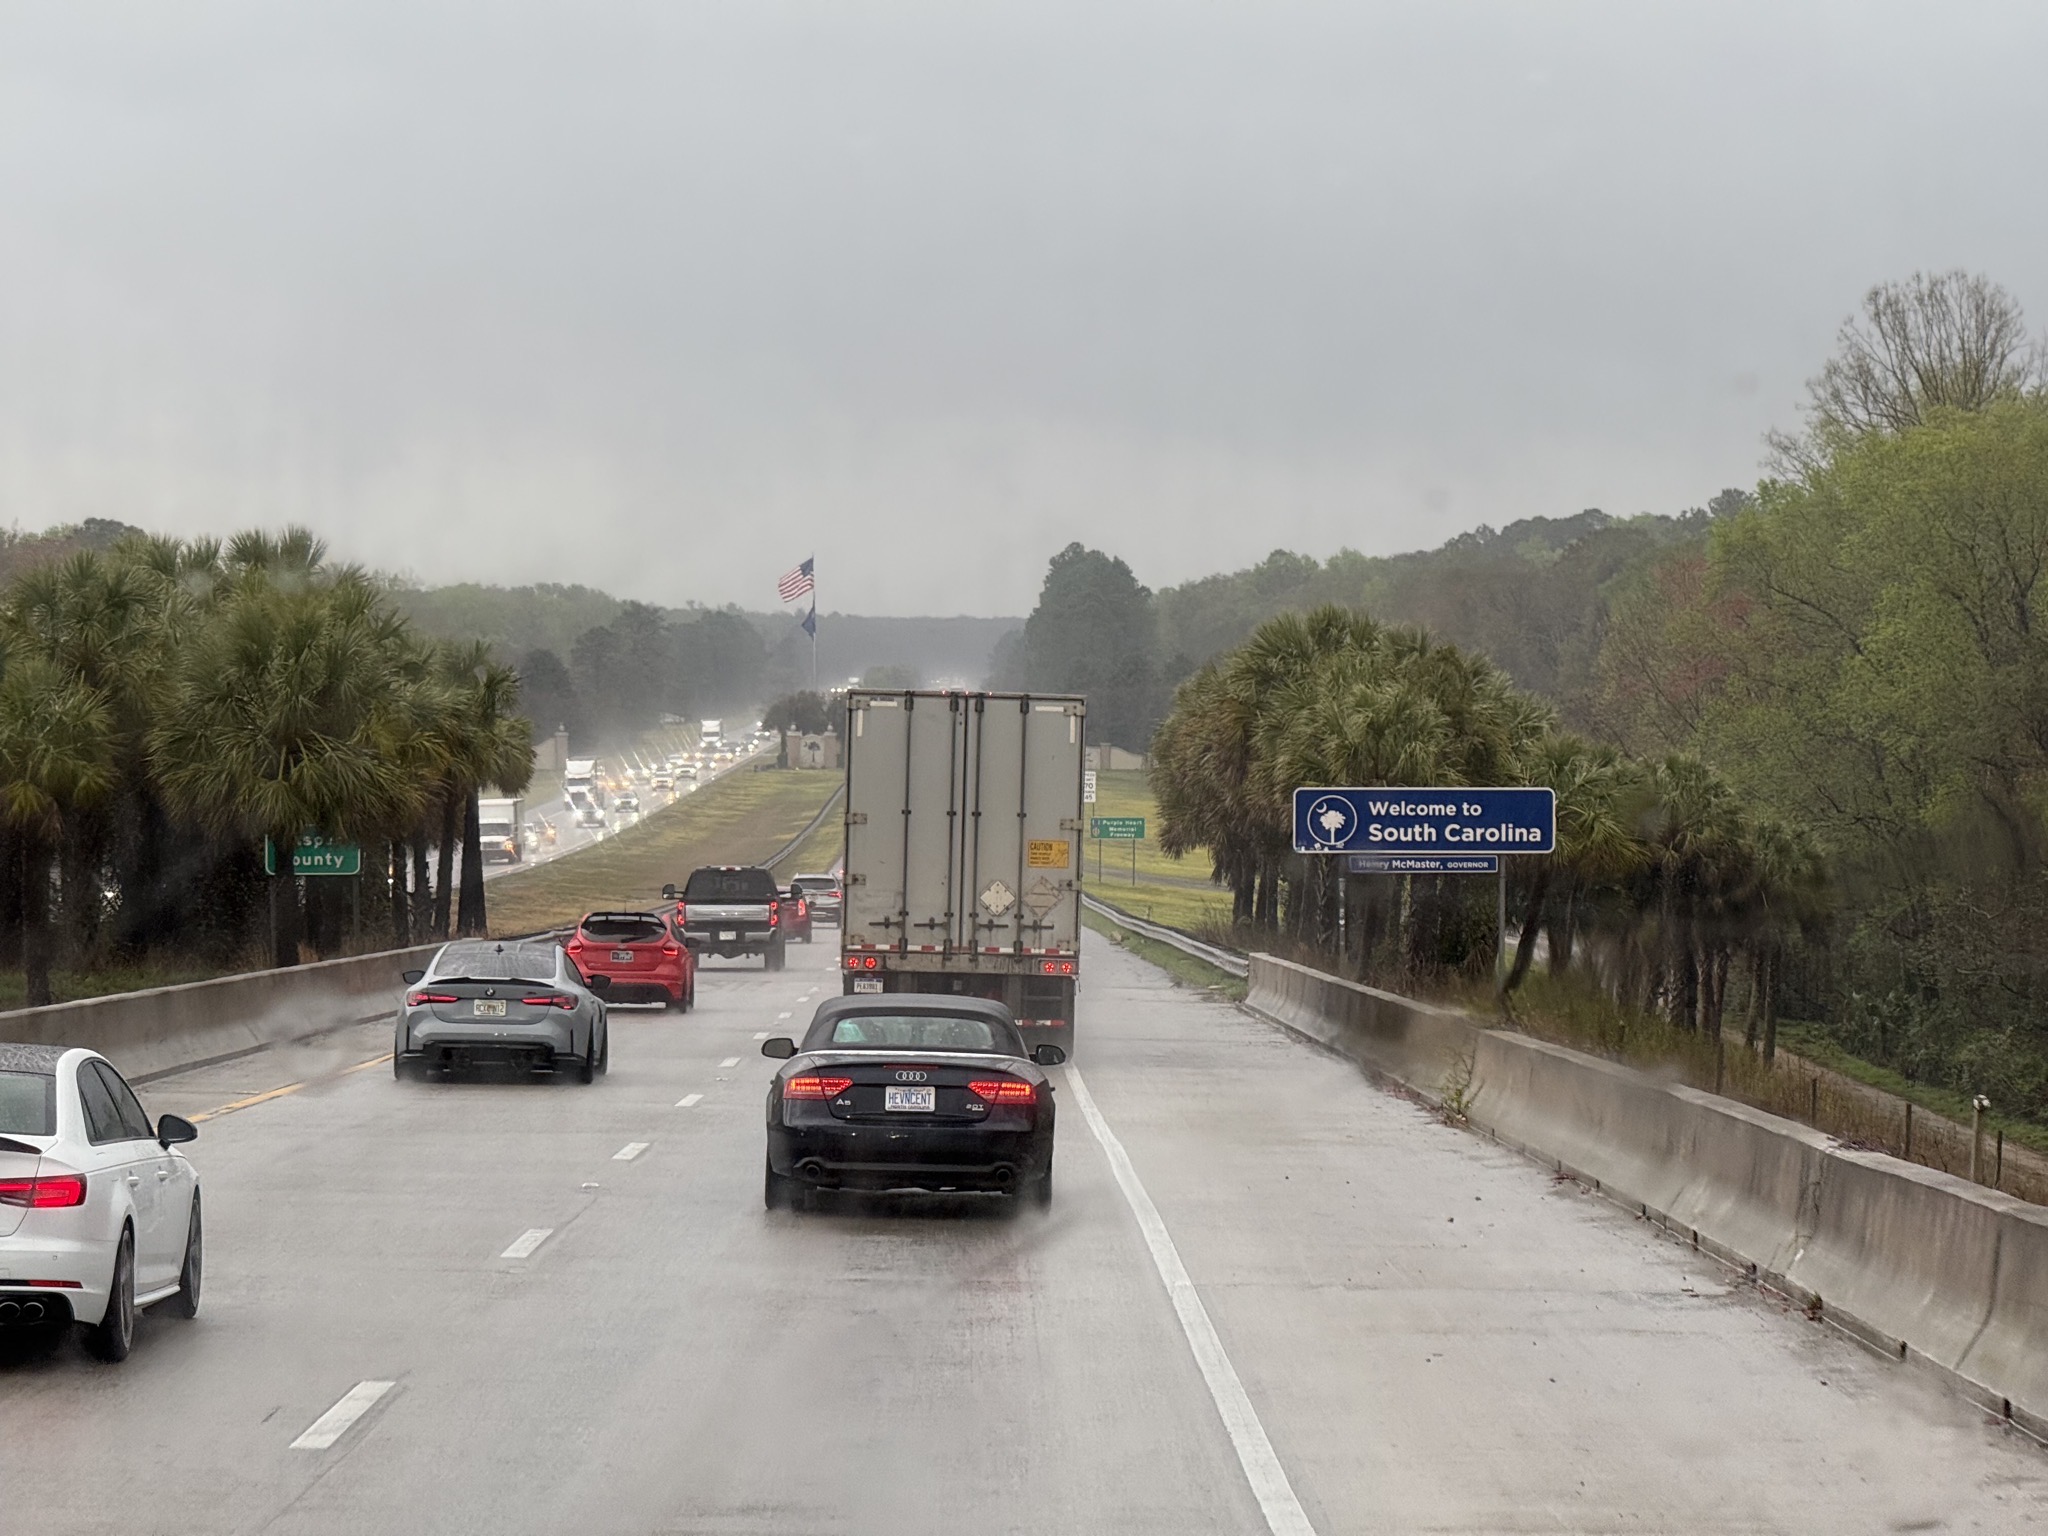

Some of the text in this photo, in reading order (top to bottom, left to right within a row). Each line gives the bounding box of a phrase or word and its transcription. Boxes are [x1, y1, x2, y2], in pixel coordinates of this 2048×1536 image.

[1369, 801, 1482, 816] Welcome to
[1368, 823, 1542, 842] South Carolina
[1030, 842, 1053, 851] CAUTION
[293, 853, 344, 868] ounty
[1392, 860, 1443, 869] McMaster,
[888, 1092, 932, 1105] HEVNCENT
